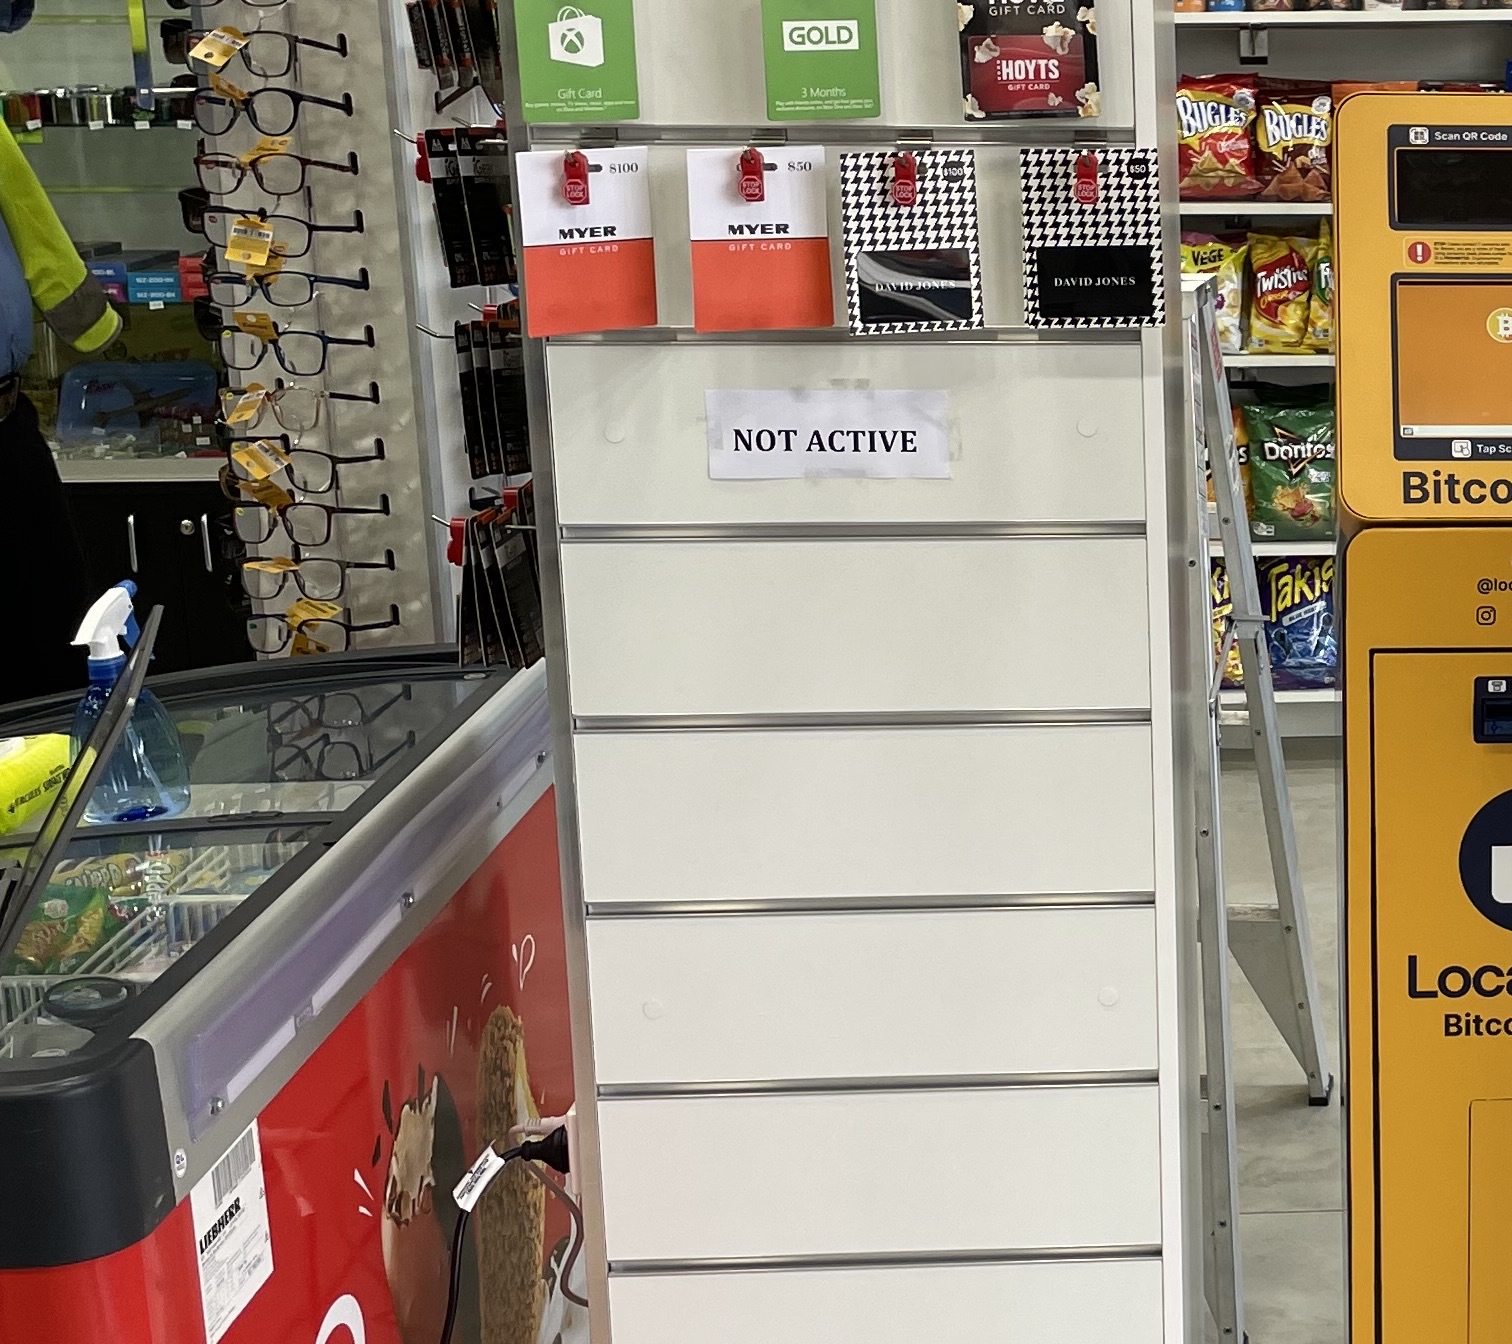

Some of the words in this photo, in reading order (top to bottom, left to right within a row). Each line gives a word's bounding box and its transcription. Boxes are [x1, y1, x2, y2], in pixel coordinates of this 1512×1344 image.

[989, 6, 1020, 16] GIFT
[1027, 4, 1066, 15] CARD
[788, 26, 853, 46] GOLD
[1000, 59, 1060, 81] HOYTS
[801, 87, 808, 98] 3
[810, 87, 847, 98] Months
[1007, 83, 1026, 91] GIFT
[1028, 83, 1051, 91] CARD
[557, 88, 576, 99] Gift
[578, 88, 602, 99] Card
[1176, 96, 1248, 138] BUGLES
[1264, 108, 1328, 147] BUGLES
[1434, 131, 1460, 142] Scan
[1462, 131, 1478, 143] QR
[1480, 131, 1508, 142] Code
[609, 161, 639, 174] $100
[787, 161, 812, 172] $50
[1129, 164, 1147, 174] $50
[566, 184, 585, 192] STOP
[742, 181, 761, 189] STOP
[896, 184, 913, 192] STOP
[566, 191, 585, 199] LOCK
[742, 188, 761, 196] LOCK
[896, 191, 913, 199] LOCK
[559, 225, 617, 240] MYER
[728, 223, 790, 236] MYER
[559, 247, 585, 256] GIFT
[589, 244, 619, 254] CARD
[729, 243, 755, 252] GIFT
[761, 242, 792, 251] CARD
[1191, 248, 1225, 266] VEGE
[875, 281, 913, 292] DAVID
[916, 280, 956, 291] JONES
[1054, 277, 1092, 287] DAVID
[1095, 276, 1136, 287] JONES
[733, 429, 798, 452] NOT
[806, 430, 918, 453] ACTIVE
[1264, 440, 1335, 460] Doritos
[1477, 443, 1496, 454] Tap
[1269, 558, 1335, 622] Takis
[199, 1196, 241, 1255] LIEBHERR
